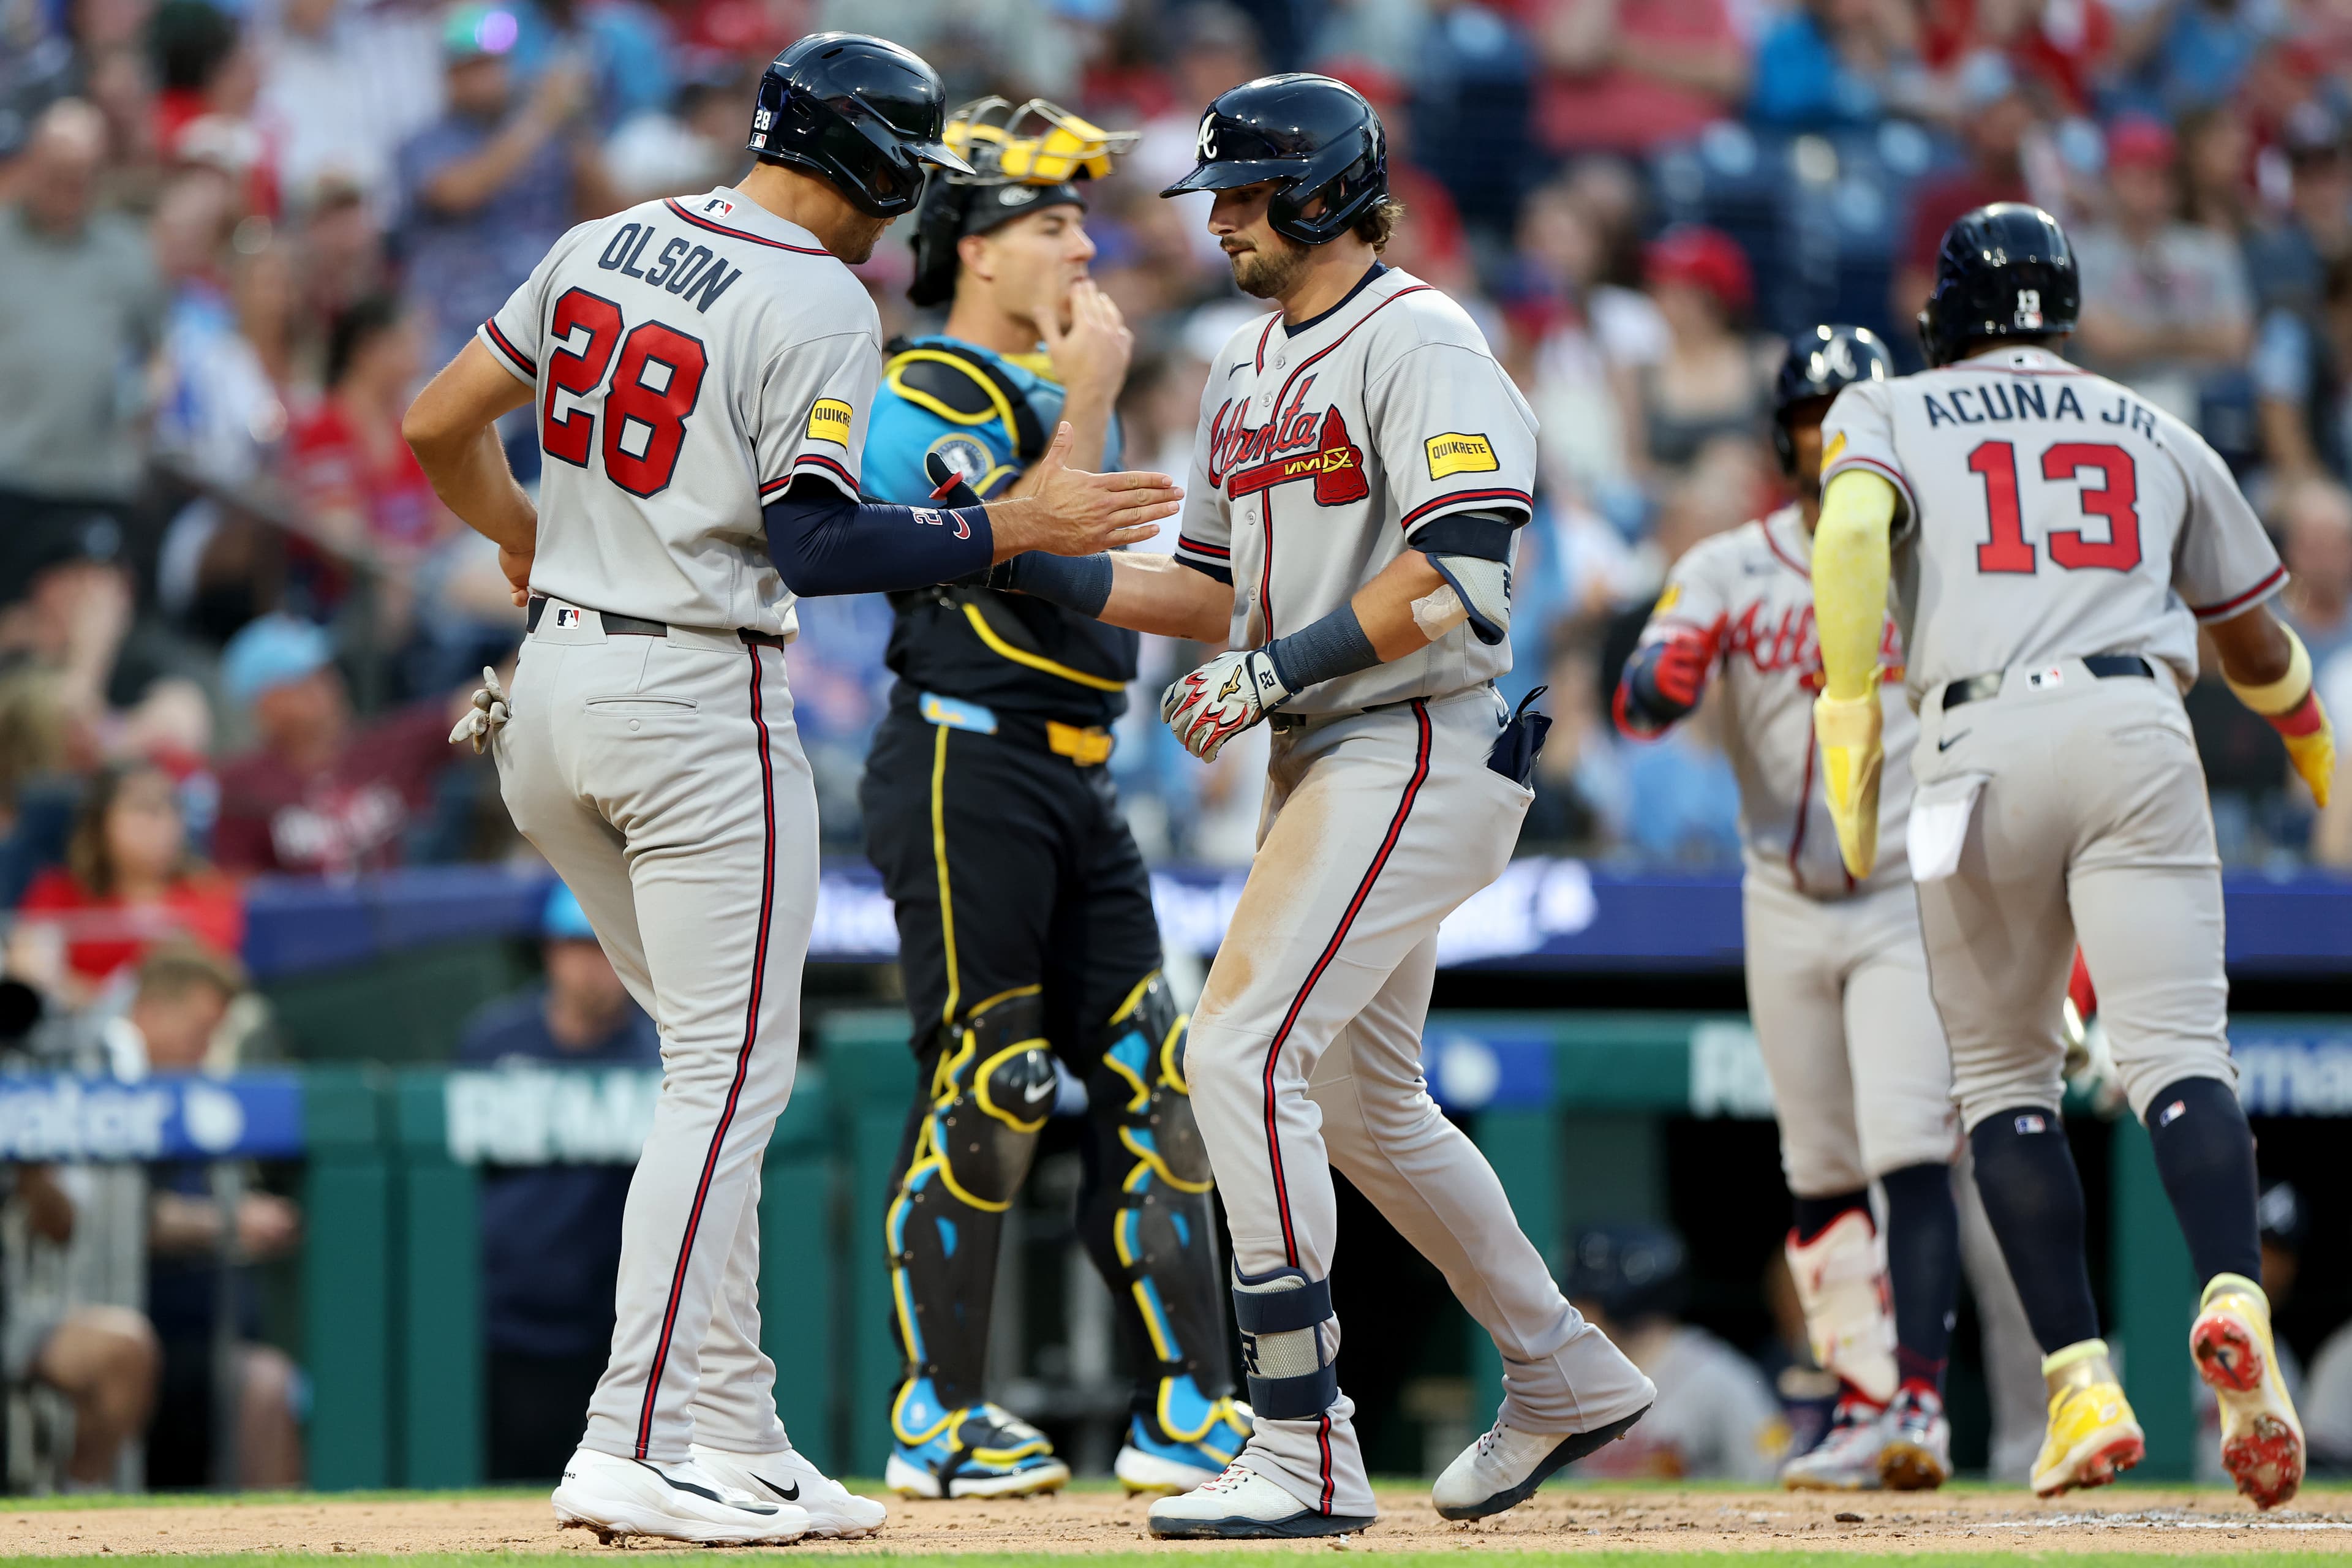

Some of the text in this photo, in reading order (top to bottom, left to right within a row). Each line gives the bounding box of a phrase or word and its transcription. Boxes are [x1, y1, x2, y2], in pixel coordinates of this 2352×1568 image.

[754, 109, 771, 130] 28
[1195, 112, 1217, 160] A
[598, 222, 742, 314] OLSON
[2018, 289, 2040, 312] 13
[543, 286, 709, 499] 28
[815, 407, 851, 428] QUIKRE
[1209, 372, 1321, 489] Atlanta
[2100, 397, 2163, 448] JR.
[1433, 442, 1487, 459] QUIKRETE
[908, 506, 943, 526] 2
[1968, 440, 2143, 574] 13
[0, 1073, 173, 1158] ater
